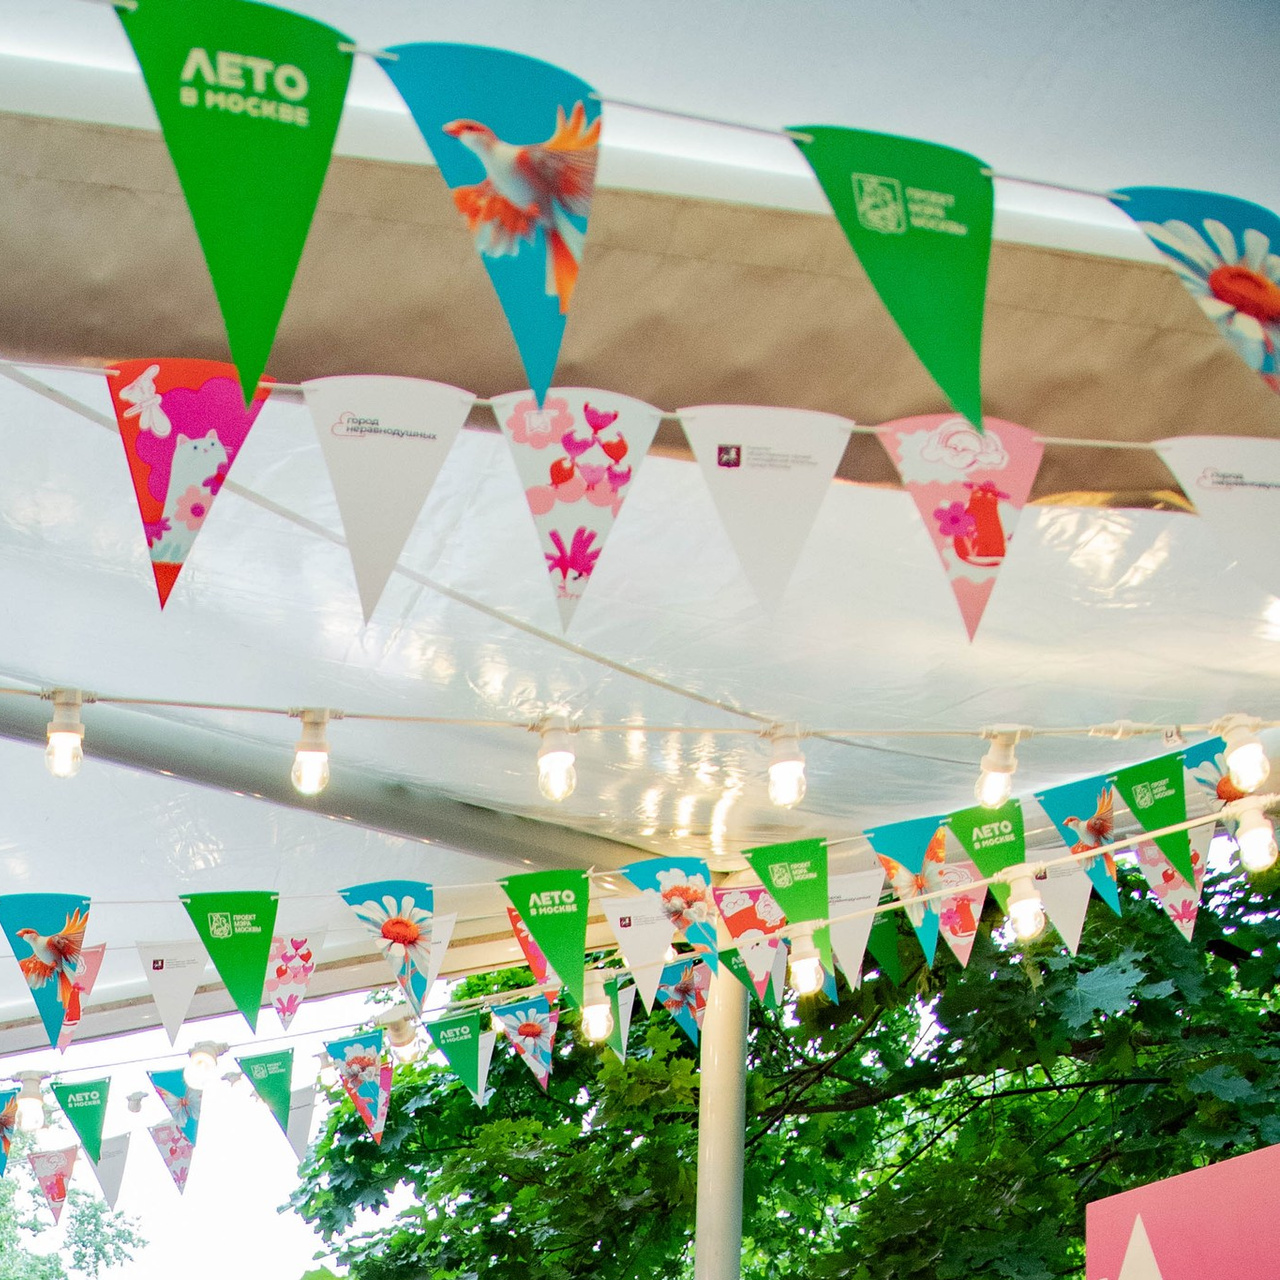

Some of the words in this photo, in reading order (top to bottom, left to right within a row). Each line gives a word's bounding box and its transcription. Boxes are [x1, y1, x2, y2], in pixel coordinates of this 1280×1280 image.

[181, 48, 309, 102] ЛЕТО
[205, 90, 310, 128] МОСКВЕ
[347, 416, 379, 427] город
[346, 425, 438, 440] неравнодушных
[973, 821, 1013, 841] ЛЕТО
[529, 890, 576, 908] ЛЕТО
[540, 904, 578, 915] МОСКВЕ
[440, 1026, 470, 1039] ЛЕТО
[68, 1091, 100, 1103] ЛЕТО
